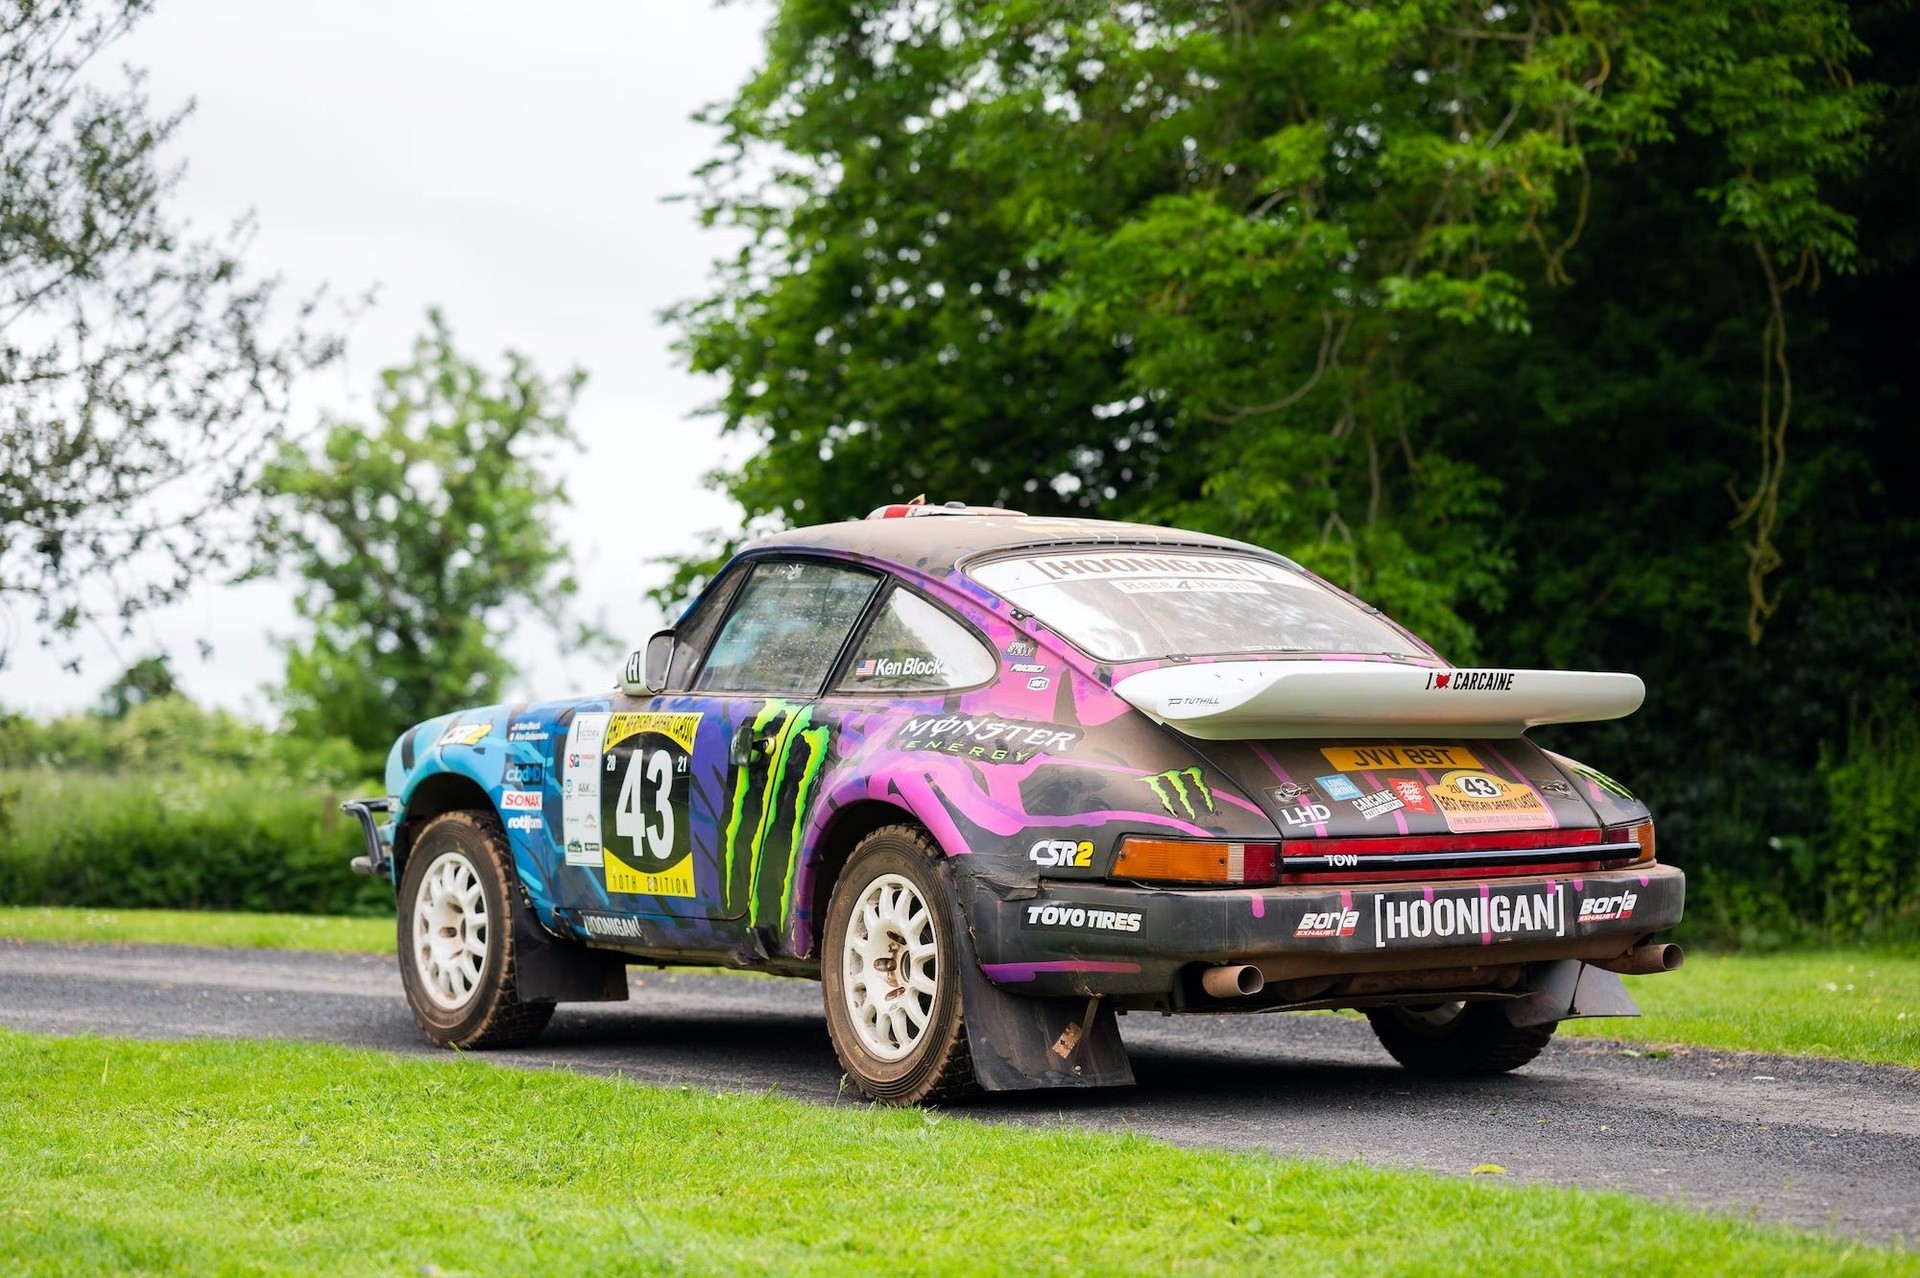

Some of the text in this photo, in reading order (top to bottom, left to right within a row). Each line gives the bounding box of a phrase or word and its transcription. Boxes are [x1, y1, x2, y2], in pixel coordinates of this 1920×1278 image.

[1176, 580, 1191, 590] 4
[875, 657, 943, 677] Ken Block
[1425, 672, 1515, 691] I CARCAINE
[1184, 697, 1220, 705] TUTHILL
[906, 740, 1030, 762] ENERGY
[1354, 748, 1457, 767] JVV 89T
[606, 754, 616, 771] 20
[677, 755, 688, 772] 21
[1464, 778, 1498, 796] 43
[1496, 783, 1511, 792] 21
[505, 794, 541, 807] SONAX
[616, 749, 675, 860] 43
[1351, 788, 1397, 812] CARCAINE
[1434, 793, 1461, 811] EAST
[1458, 799, 1492, 812] AFRICAN
[1491, 799, 1516, 811] SAFARI
[1281, 804, 1332, 825] LHD
[1029, 839, 1095, 867] CSR2
[1324, 854, 1358, 867] TOW
[613, 874, 689, 894] 10TH EDITION
[1027, 906, 1142, 932] TOYO TIRES
